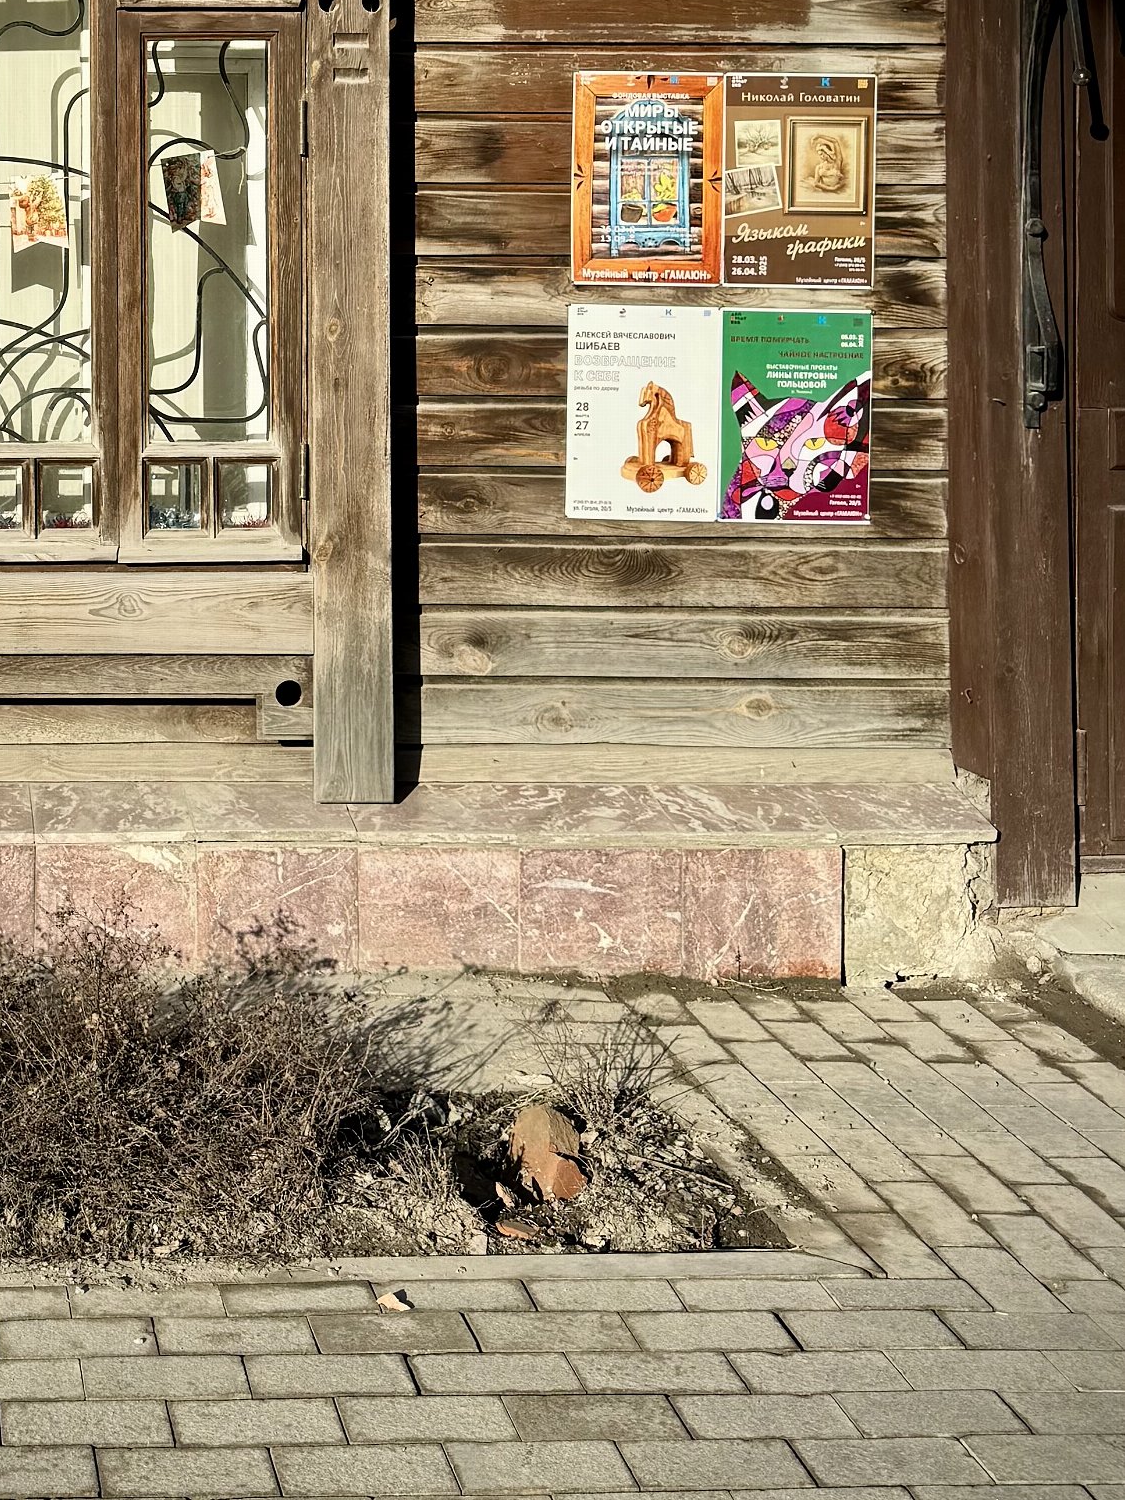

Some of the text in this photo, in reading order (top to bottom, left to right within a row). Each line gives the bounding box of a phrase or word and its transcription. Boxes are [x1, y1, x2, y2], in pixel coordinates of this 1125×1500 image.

[651, 92, 690, 100] ВЫСТАВКА
[741, 92, 860, 103] Николай Головатин
[625, 104, 679, 118] МИРЫ
[600, 119, 699, 135] ОТКРЫТЫЕ
[604, 135, 694, 152] И ТАЙНЫЕ
[732, 223, 809, 243] Языком
[786, 235, 866, 261] графики
[732, 255, 768, 275] 28.03. 2025
[582, 268, 712, 281] Музейный центр «ГАМАЮН»
[731, 267, 758, 276] 26.04.
[575, 331, 676, 340] АЛЕКСЕЙ ВЯЧЕСЛАВОВИЧ
[575, 342, 620, 351] ШИБАЕВ
[813, 351, 864, 359] НАСТРОЕНИЕ
[574, 355, 676, 369] ВОЗВРАЩЕНИЕ
[574, 370, 620, 382] К СЕБЕ
[793, 372, 838, 380] ПЕТРОВНЫ
[777, 380, 827, 389] ГОЛЬЦОВОЙ
[576, 402, 589, 411] 28
[575, 420, 589, 430] 27
[627, 505, 709, 515] Музейный центр «ГАМАЮН»
